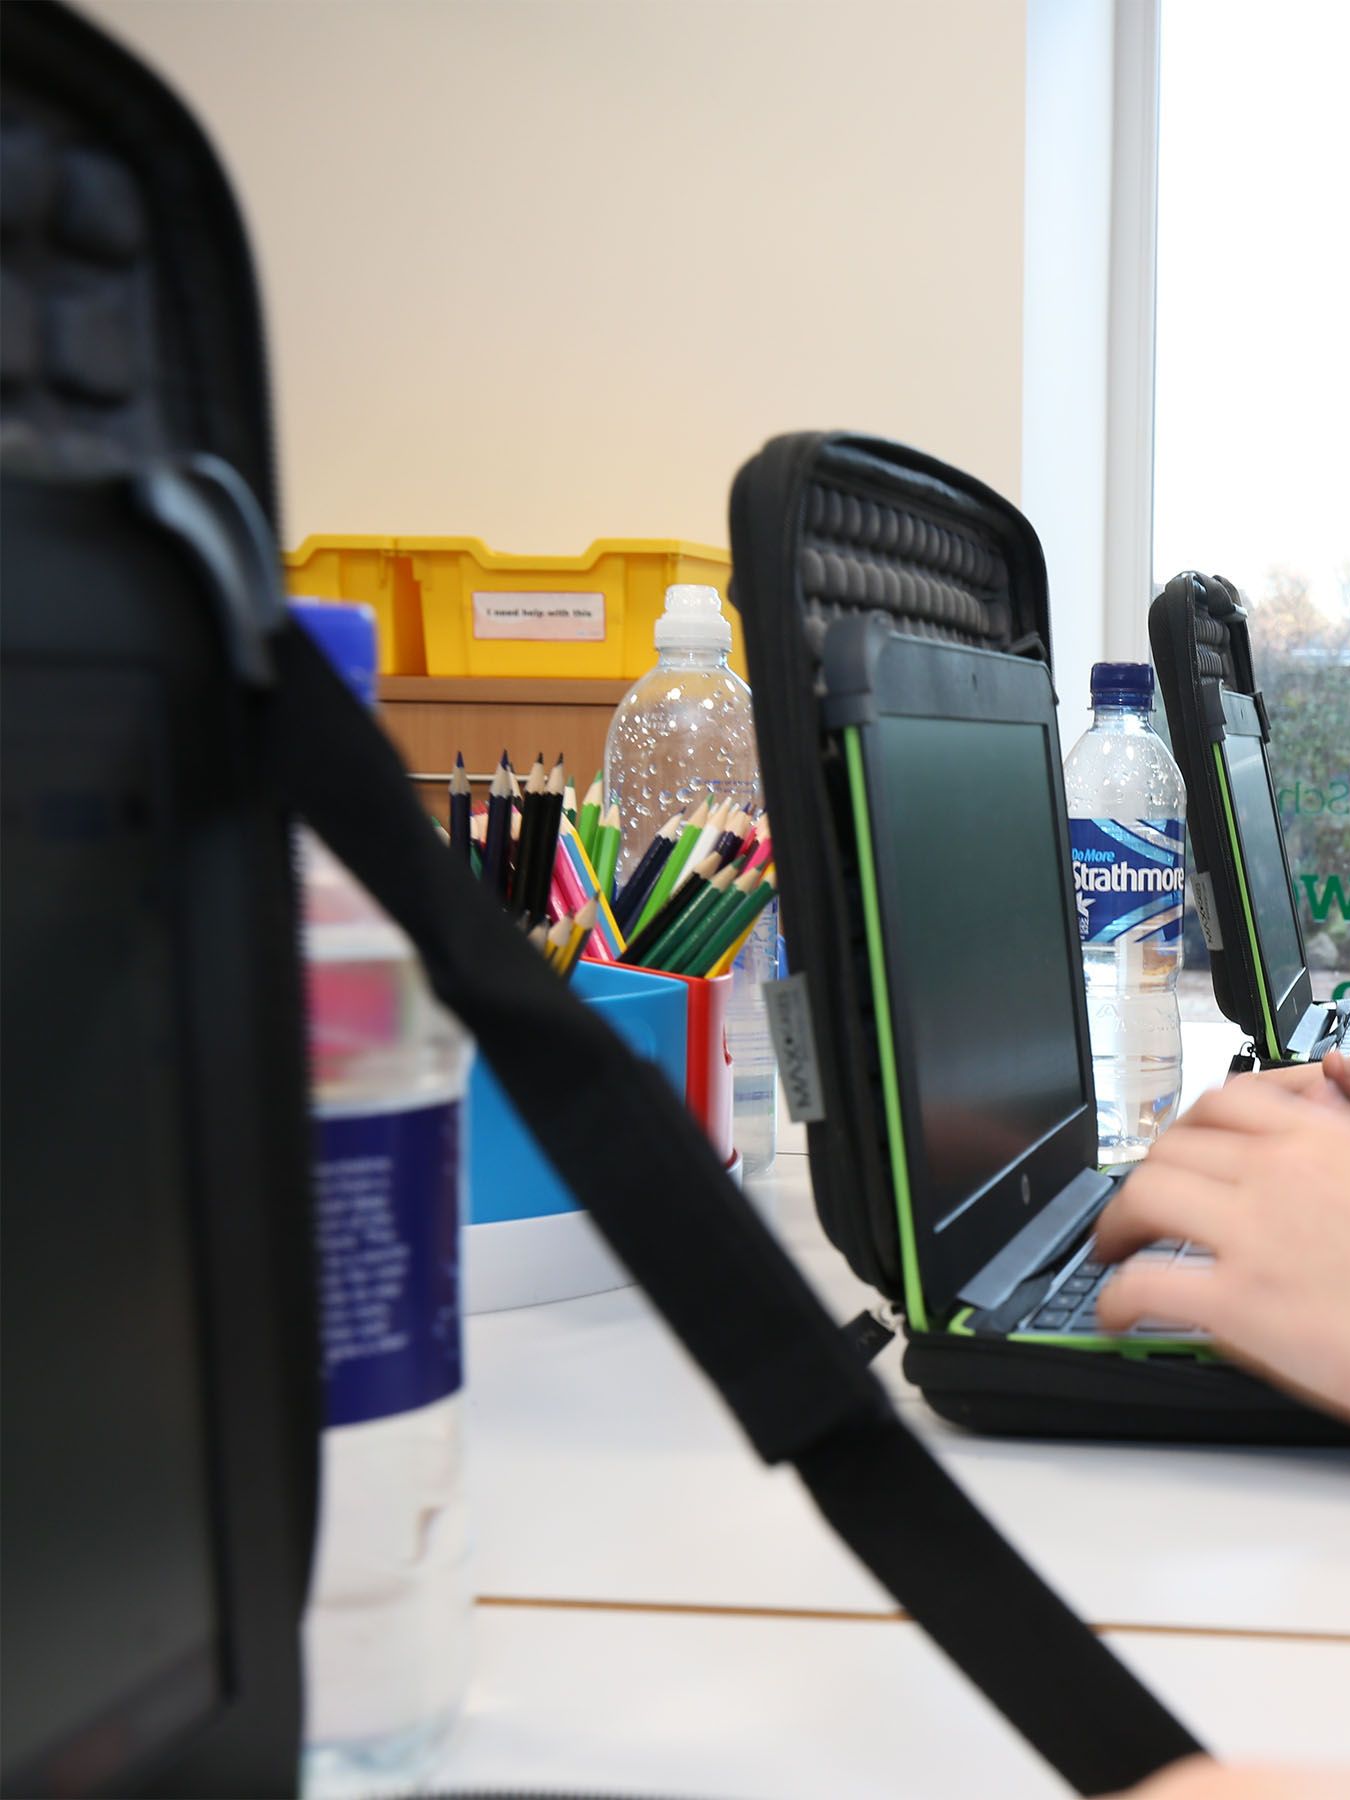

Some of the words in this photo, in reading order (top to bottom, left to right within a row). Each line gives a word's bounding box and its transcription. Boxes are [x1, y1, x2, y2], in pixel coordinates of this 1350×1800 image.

[494, 609, 519, 617] need
[522, 608, 544, 619] help
[547, 609, 570, 617] with
[573, 609, 593, 617] this
[1085, 848, 1116, 862] More
[1072, 861, 1184, 892] Strathmore
